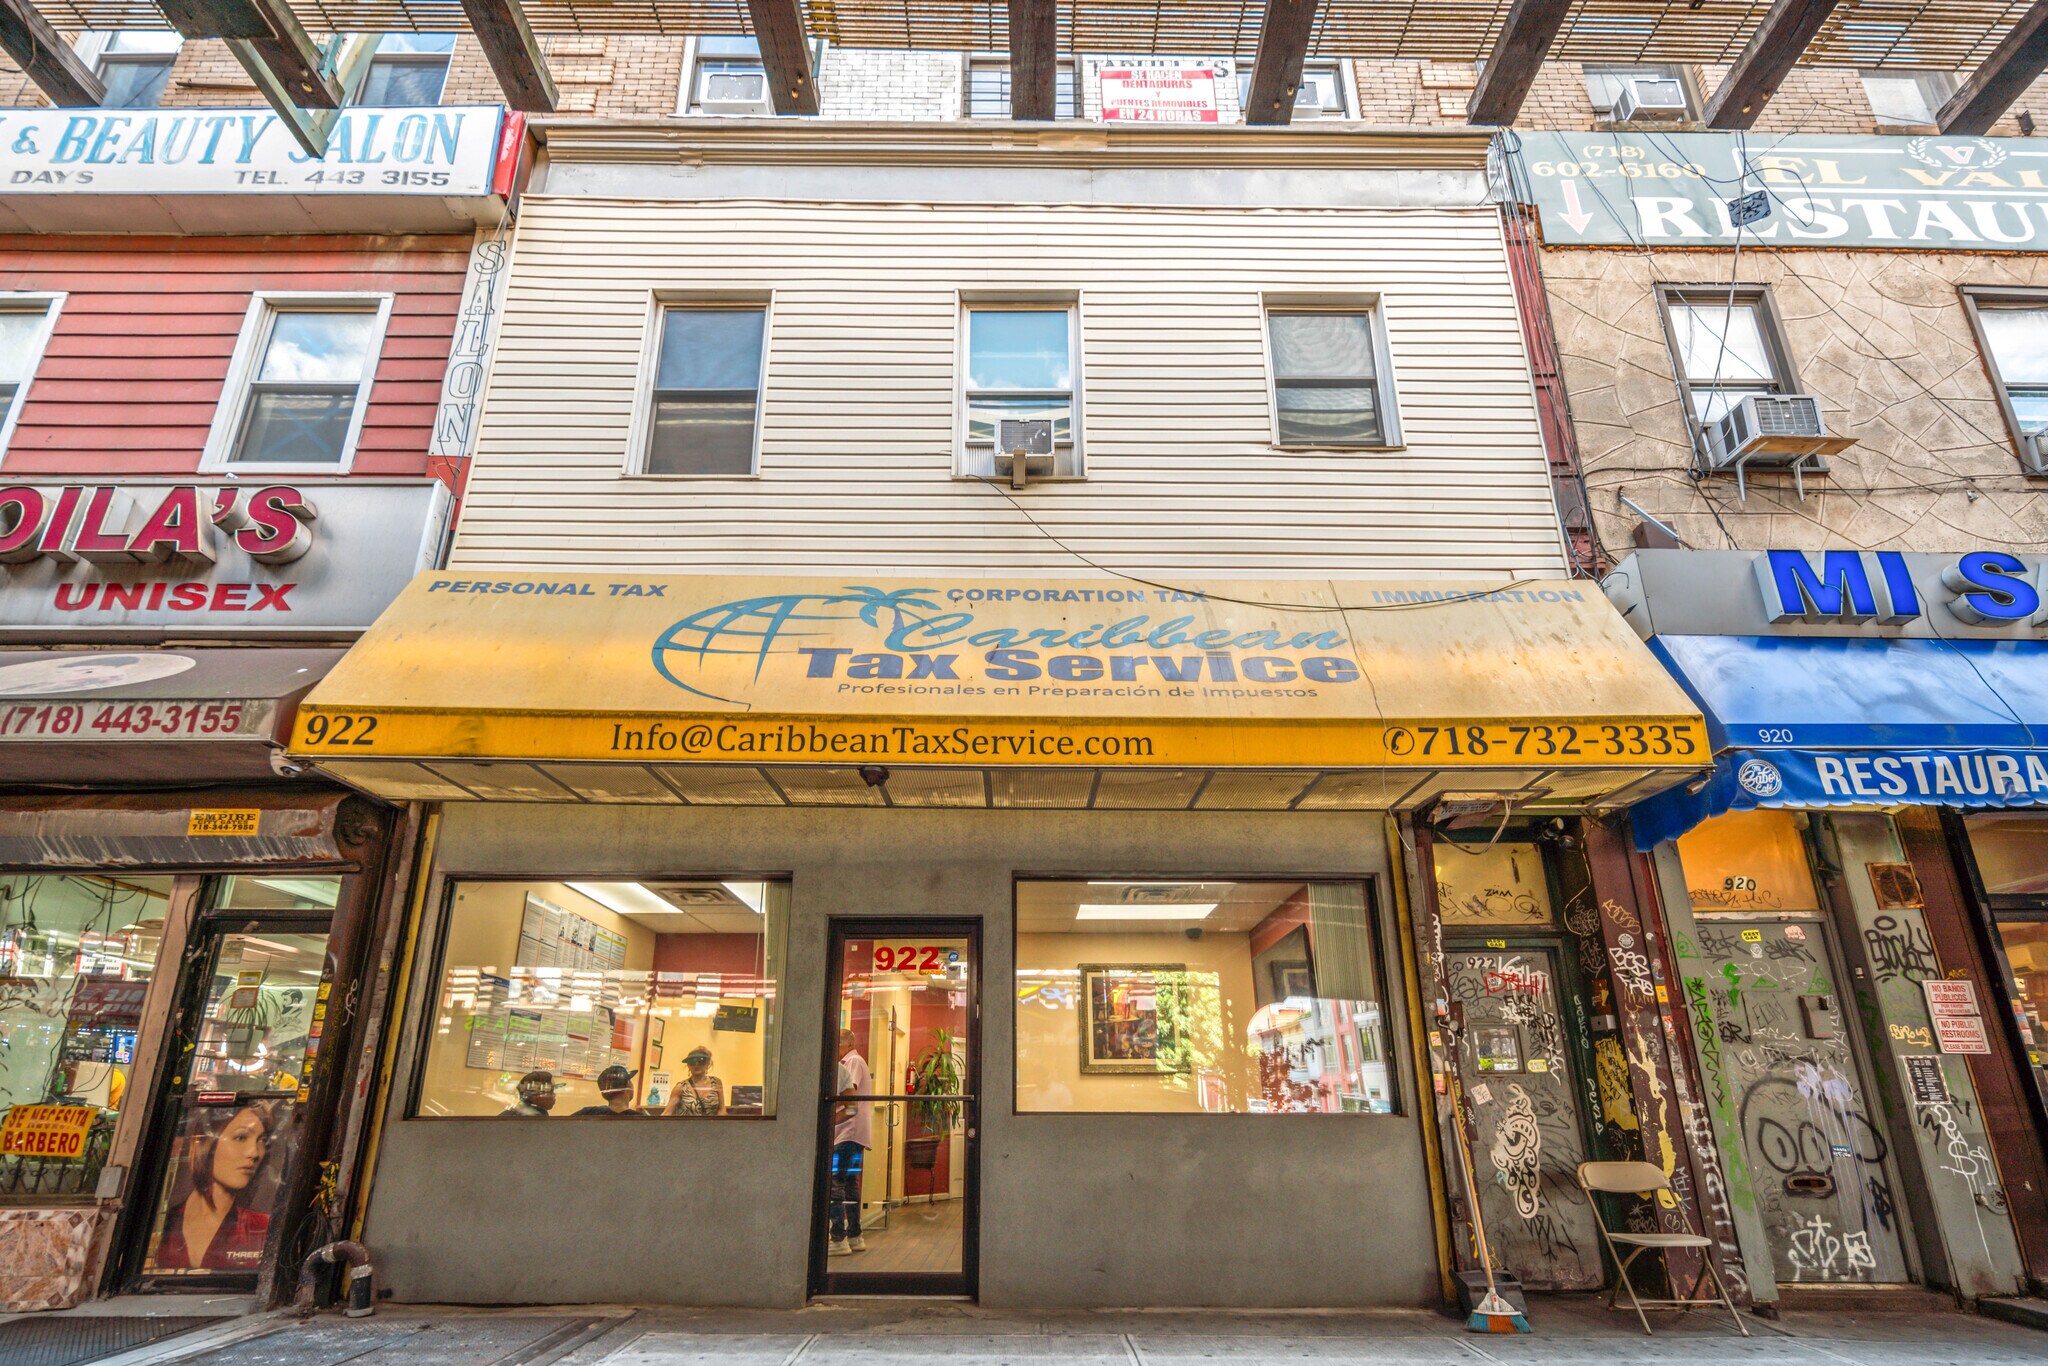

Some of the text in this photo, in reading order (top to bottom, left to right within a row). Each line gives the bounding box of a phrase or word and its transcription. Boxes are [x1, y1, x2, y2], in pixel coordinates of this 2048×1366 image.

[1122, 80, 1193, 88] DENTADURAS
[1131, 70, 1182, 79] SE HACEN
[1111, 99, 1208, 108] PUENTES REMOVIBLES
[1119, 109, 1202, 122] EN 24 HORAS
[11, 125, 40, 154] &
[48, 115, 277, 165] BEAUTY
[1582, 145, 1646, 160] (718)
[10, 170, 95, 184] DAYS
[234, 170, 451, 186] TEL. 443 3155
[1531, 161, 1707, 180] 602-6160
[1757, 155, 1868, 185] EL
[1629, 196, 2048, 243] RESTAU
[437, 239, 507, 445] SALON
[427, 580, 669, 598] PERSONAL TAX
[1766, 549, 1921, 616] MI
[54, 583, 298, 611] UNISEX
[946, 588, 1210, 604] CORPORATION TAX
[1371, 590, 1586, 603] IMMIGRATION
[884, 612, 1349, 652] Caribbean
[799, 647, 1361, 683] Tax Service
[837, 682, 1319, 702] Profesionales en Preparación de Impuestos
[1, 705, 242, 735] (718) 443-3155
[304, 715, 378, 746] 922
[610, 721, 1154, 756] Info@CaribbeanTaxService.com
[1758, 729, 1794, 743] 920
[1417, 725, 1696, 756] 718-732-3335
[1724, 878, 1756, 891] 920
[875, 946, 939, 971] 922
[1468, 957, 1496, 970] 922
[1941, 1020, 1974, 1028] NO PUBLIC
[1941, 1030, 1980, 1038] RESTROOMS
[8, 1107, 90, 1129] SE NECESITA
[3, 1130, 80, 1154] BARBERO
